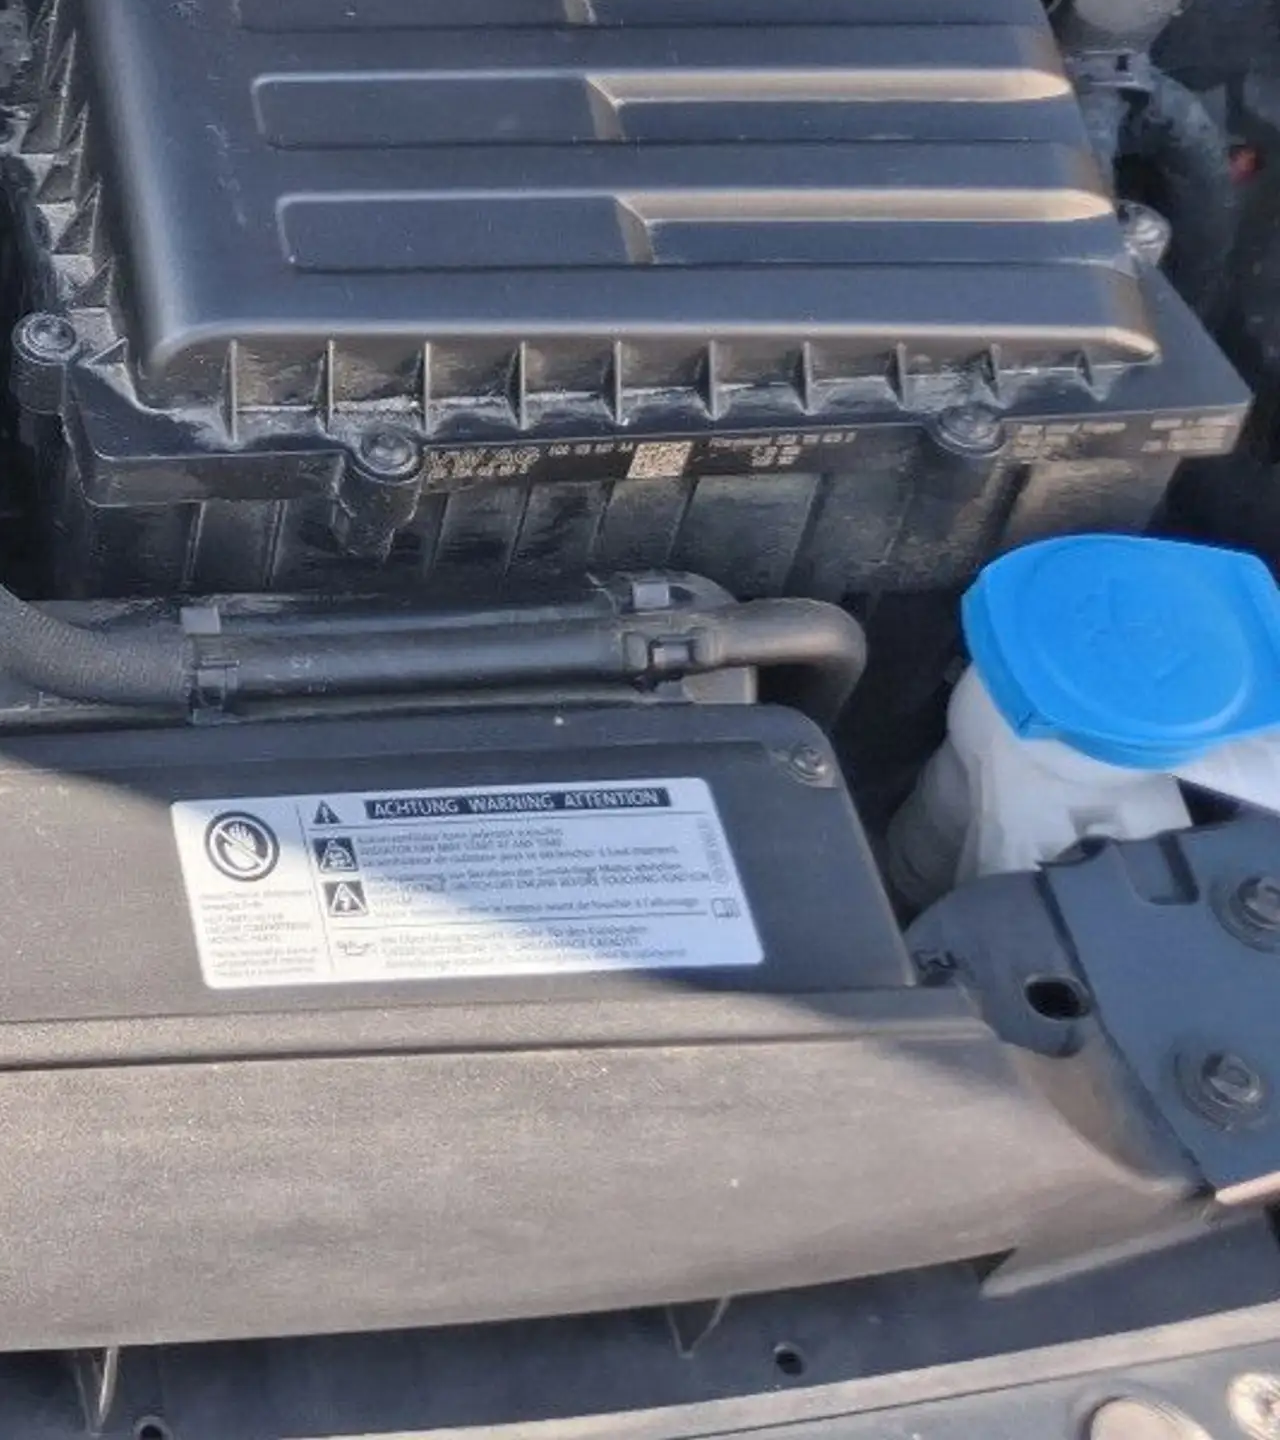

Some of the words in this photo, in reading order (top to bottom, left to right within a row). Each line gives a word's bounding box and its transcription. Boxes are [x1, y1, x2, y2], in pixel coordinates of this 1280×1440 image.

[373, 798, 459, 818] ACHTUNG
[468, 794, 555, 813] WARNING
[564, 791, 659, 808] ATTENTION
